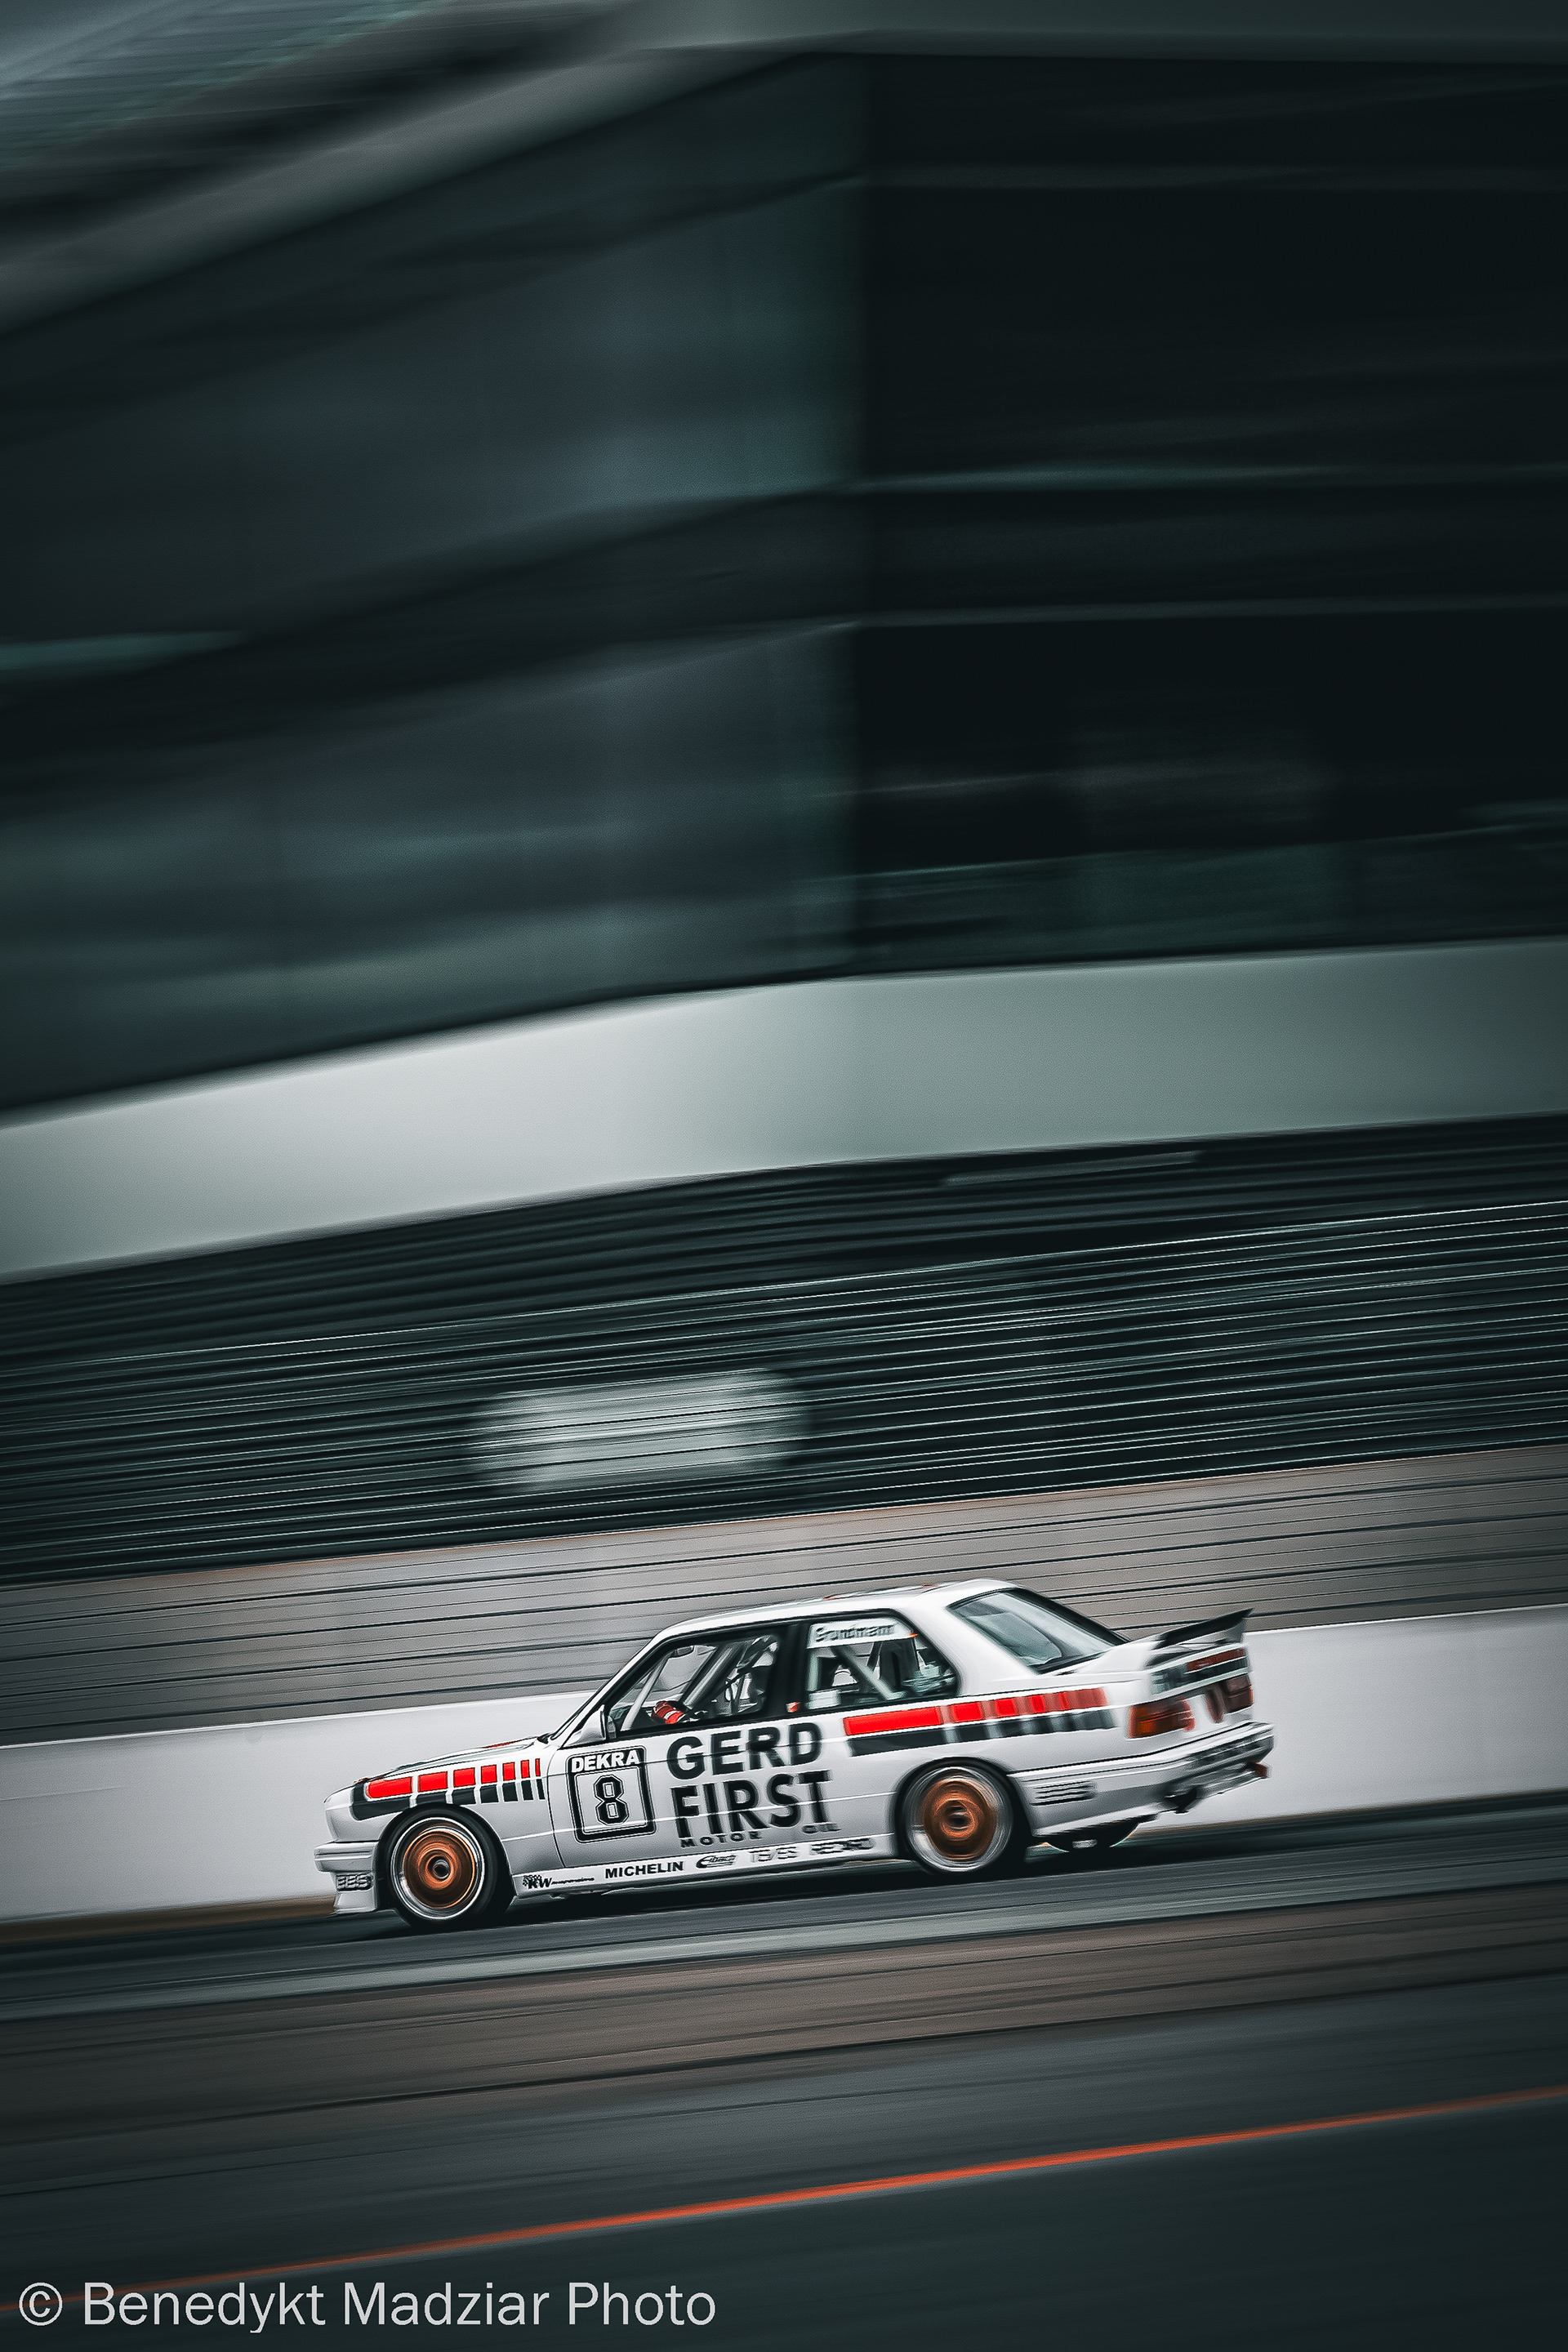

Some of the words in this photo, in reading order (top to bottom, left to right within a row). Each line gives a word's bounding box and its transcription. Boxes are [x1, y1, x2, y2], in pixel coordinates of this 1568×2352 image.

[571, 1749, 640, 1773] DEKRA
[666, 1722, 822, 1780] GERD
[593, 1774, 630, 1826] 8
[670, 1769, 834, 1838] FIRST
[680, 1831, 762, 1848] MOTOR
[605, 1861, 684, 1879] MICHELIN
[527, 1878, 553, 1890] KW
